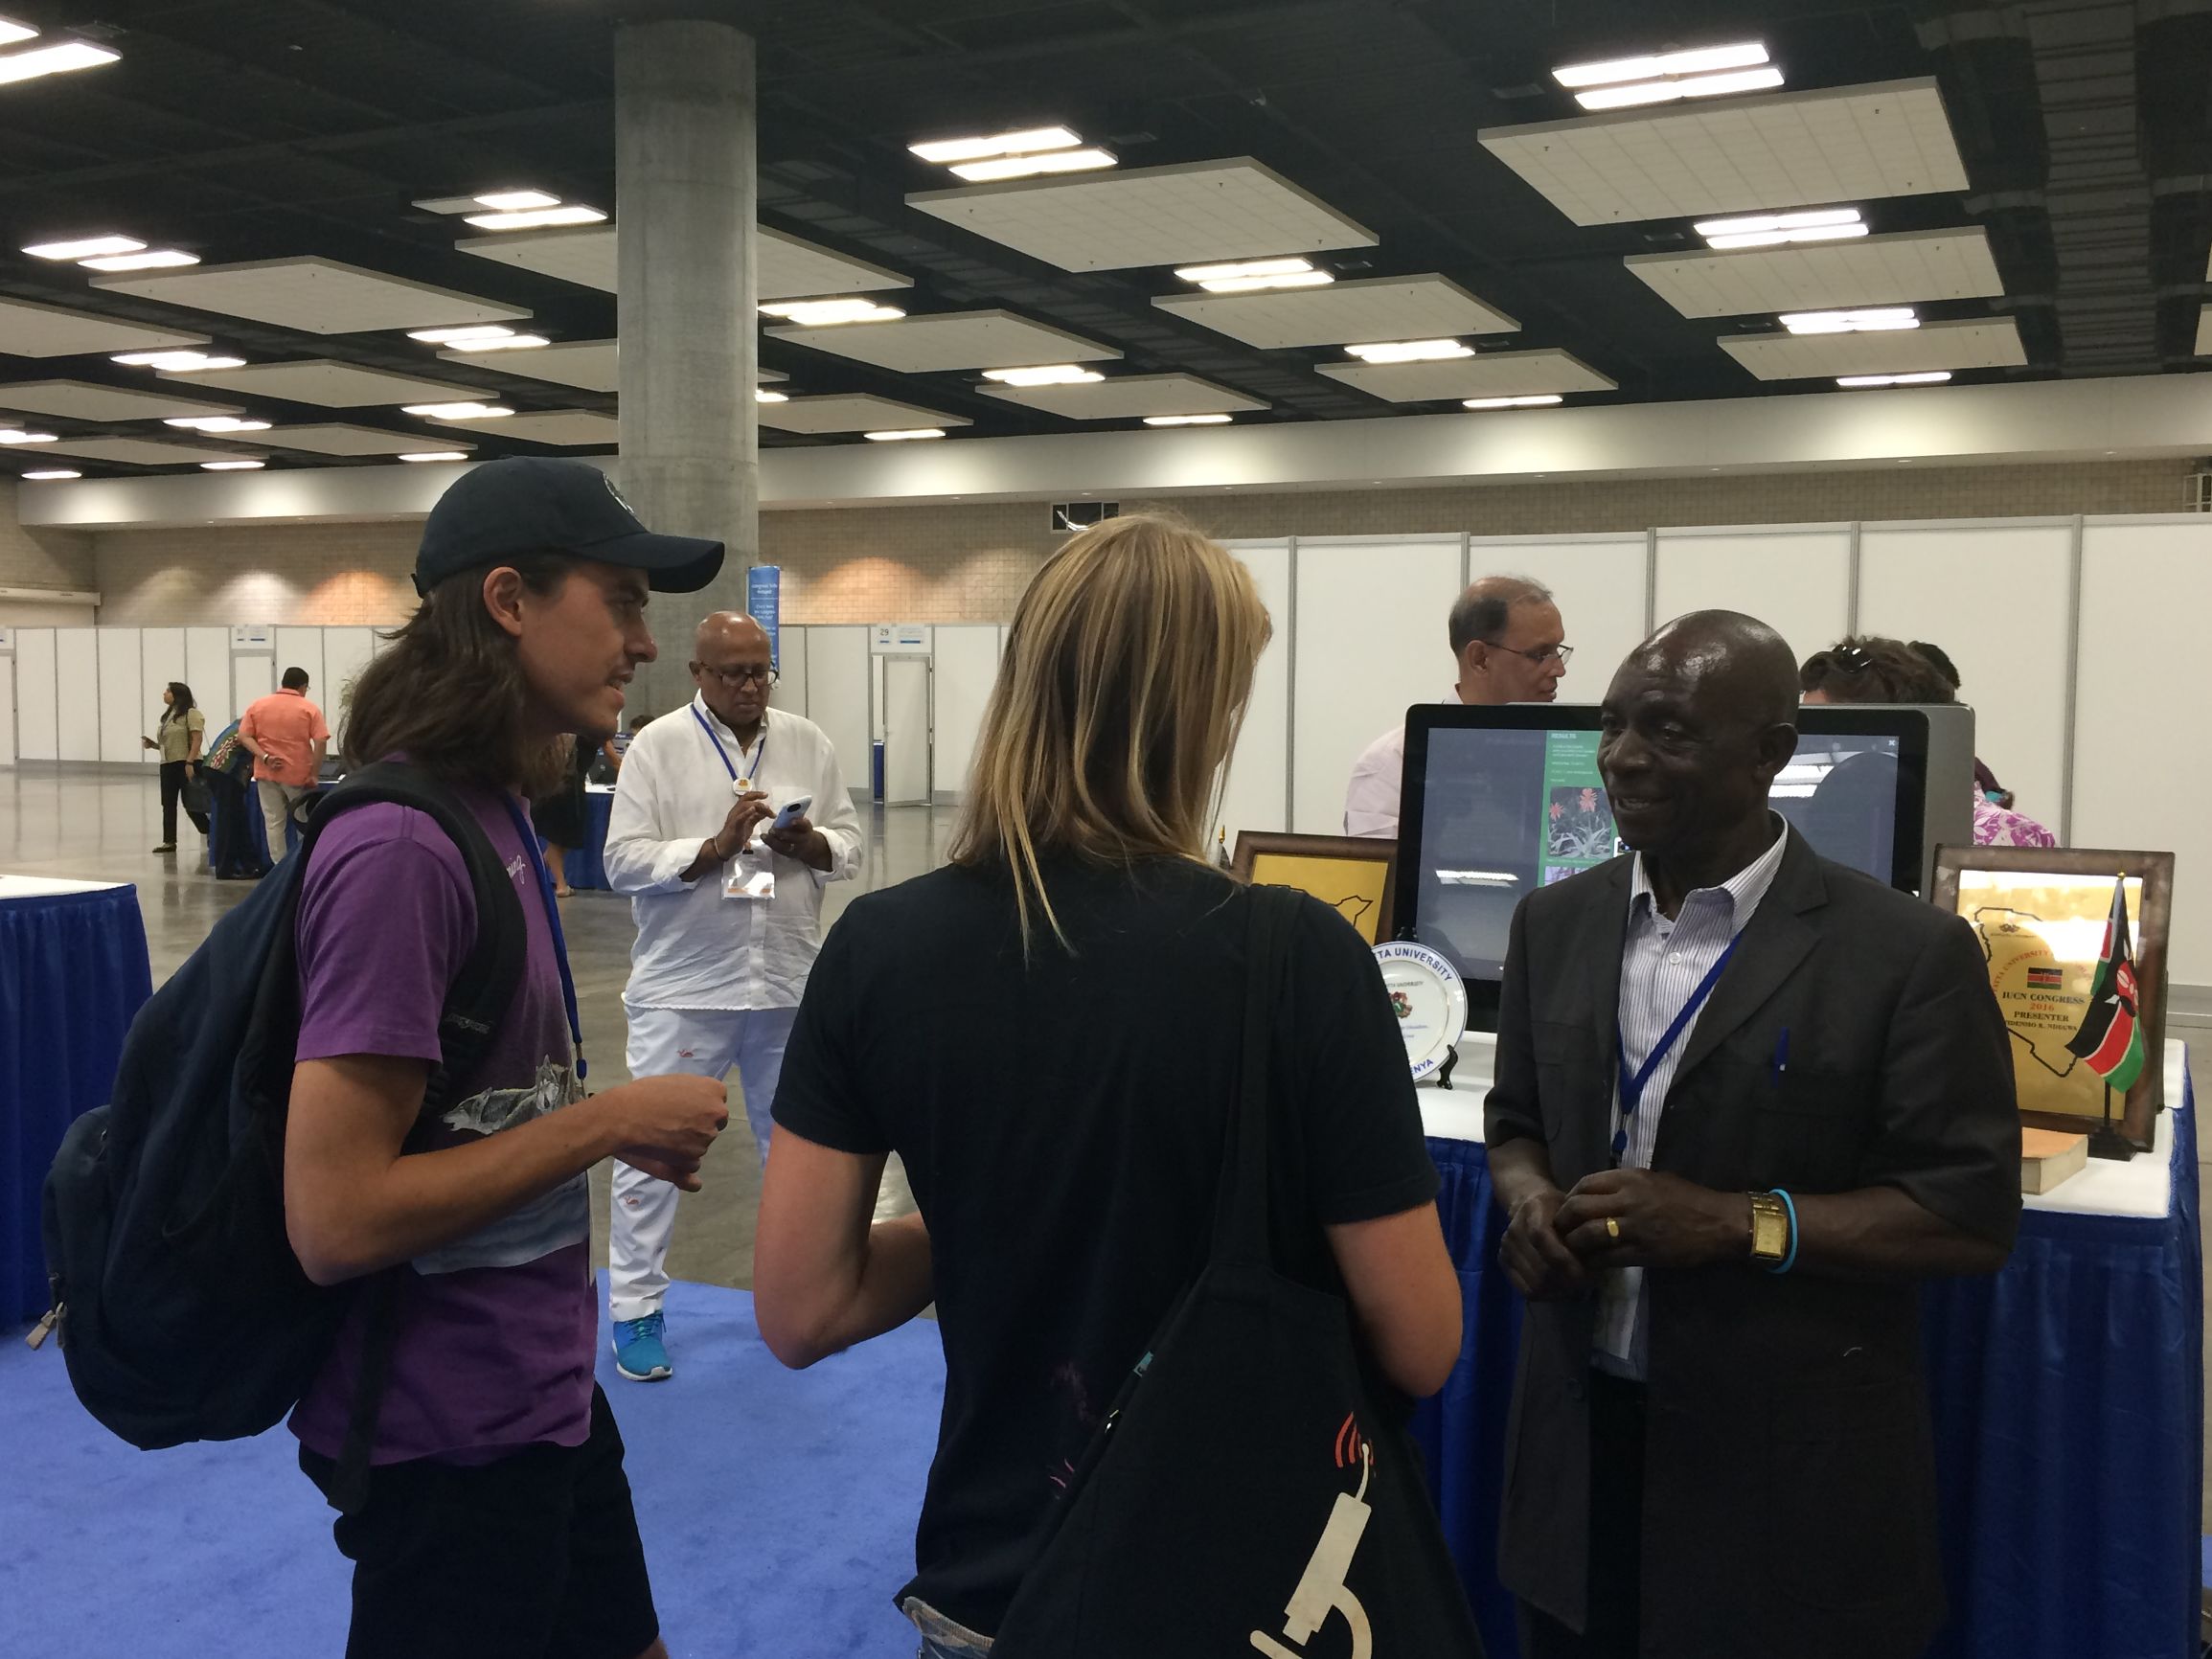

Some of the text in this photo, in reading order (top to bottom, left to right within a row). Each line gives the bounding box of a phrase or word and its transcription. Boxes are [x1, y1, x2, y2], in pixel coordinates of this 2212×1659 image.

[1376, 947, 1452, 982] TA UNIVERSITY
[2002, 991, 2086, 1005] IUCN CONGRESS
[2030, 1003, 2055, 1011] 2016
[2014, 1011, 2069, 1022] PRESENTER
